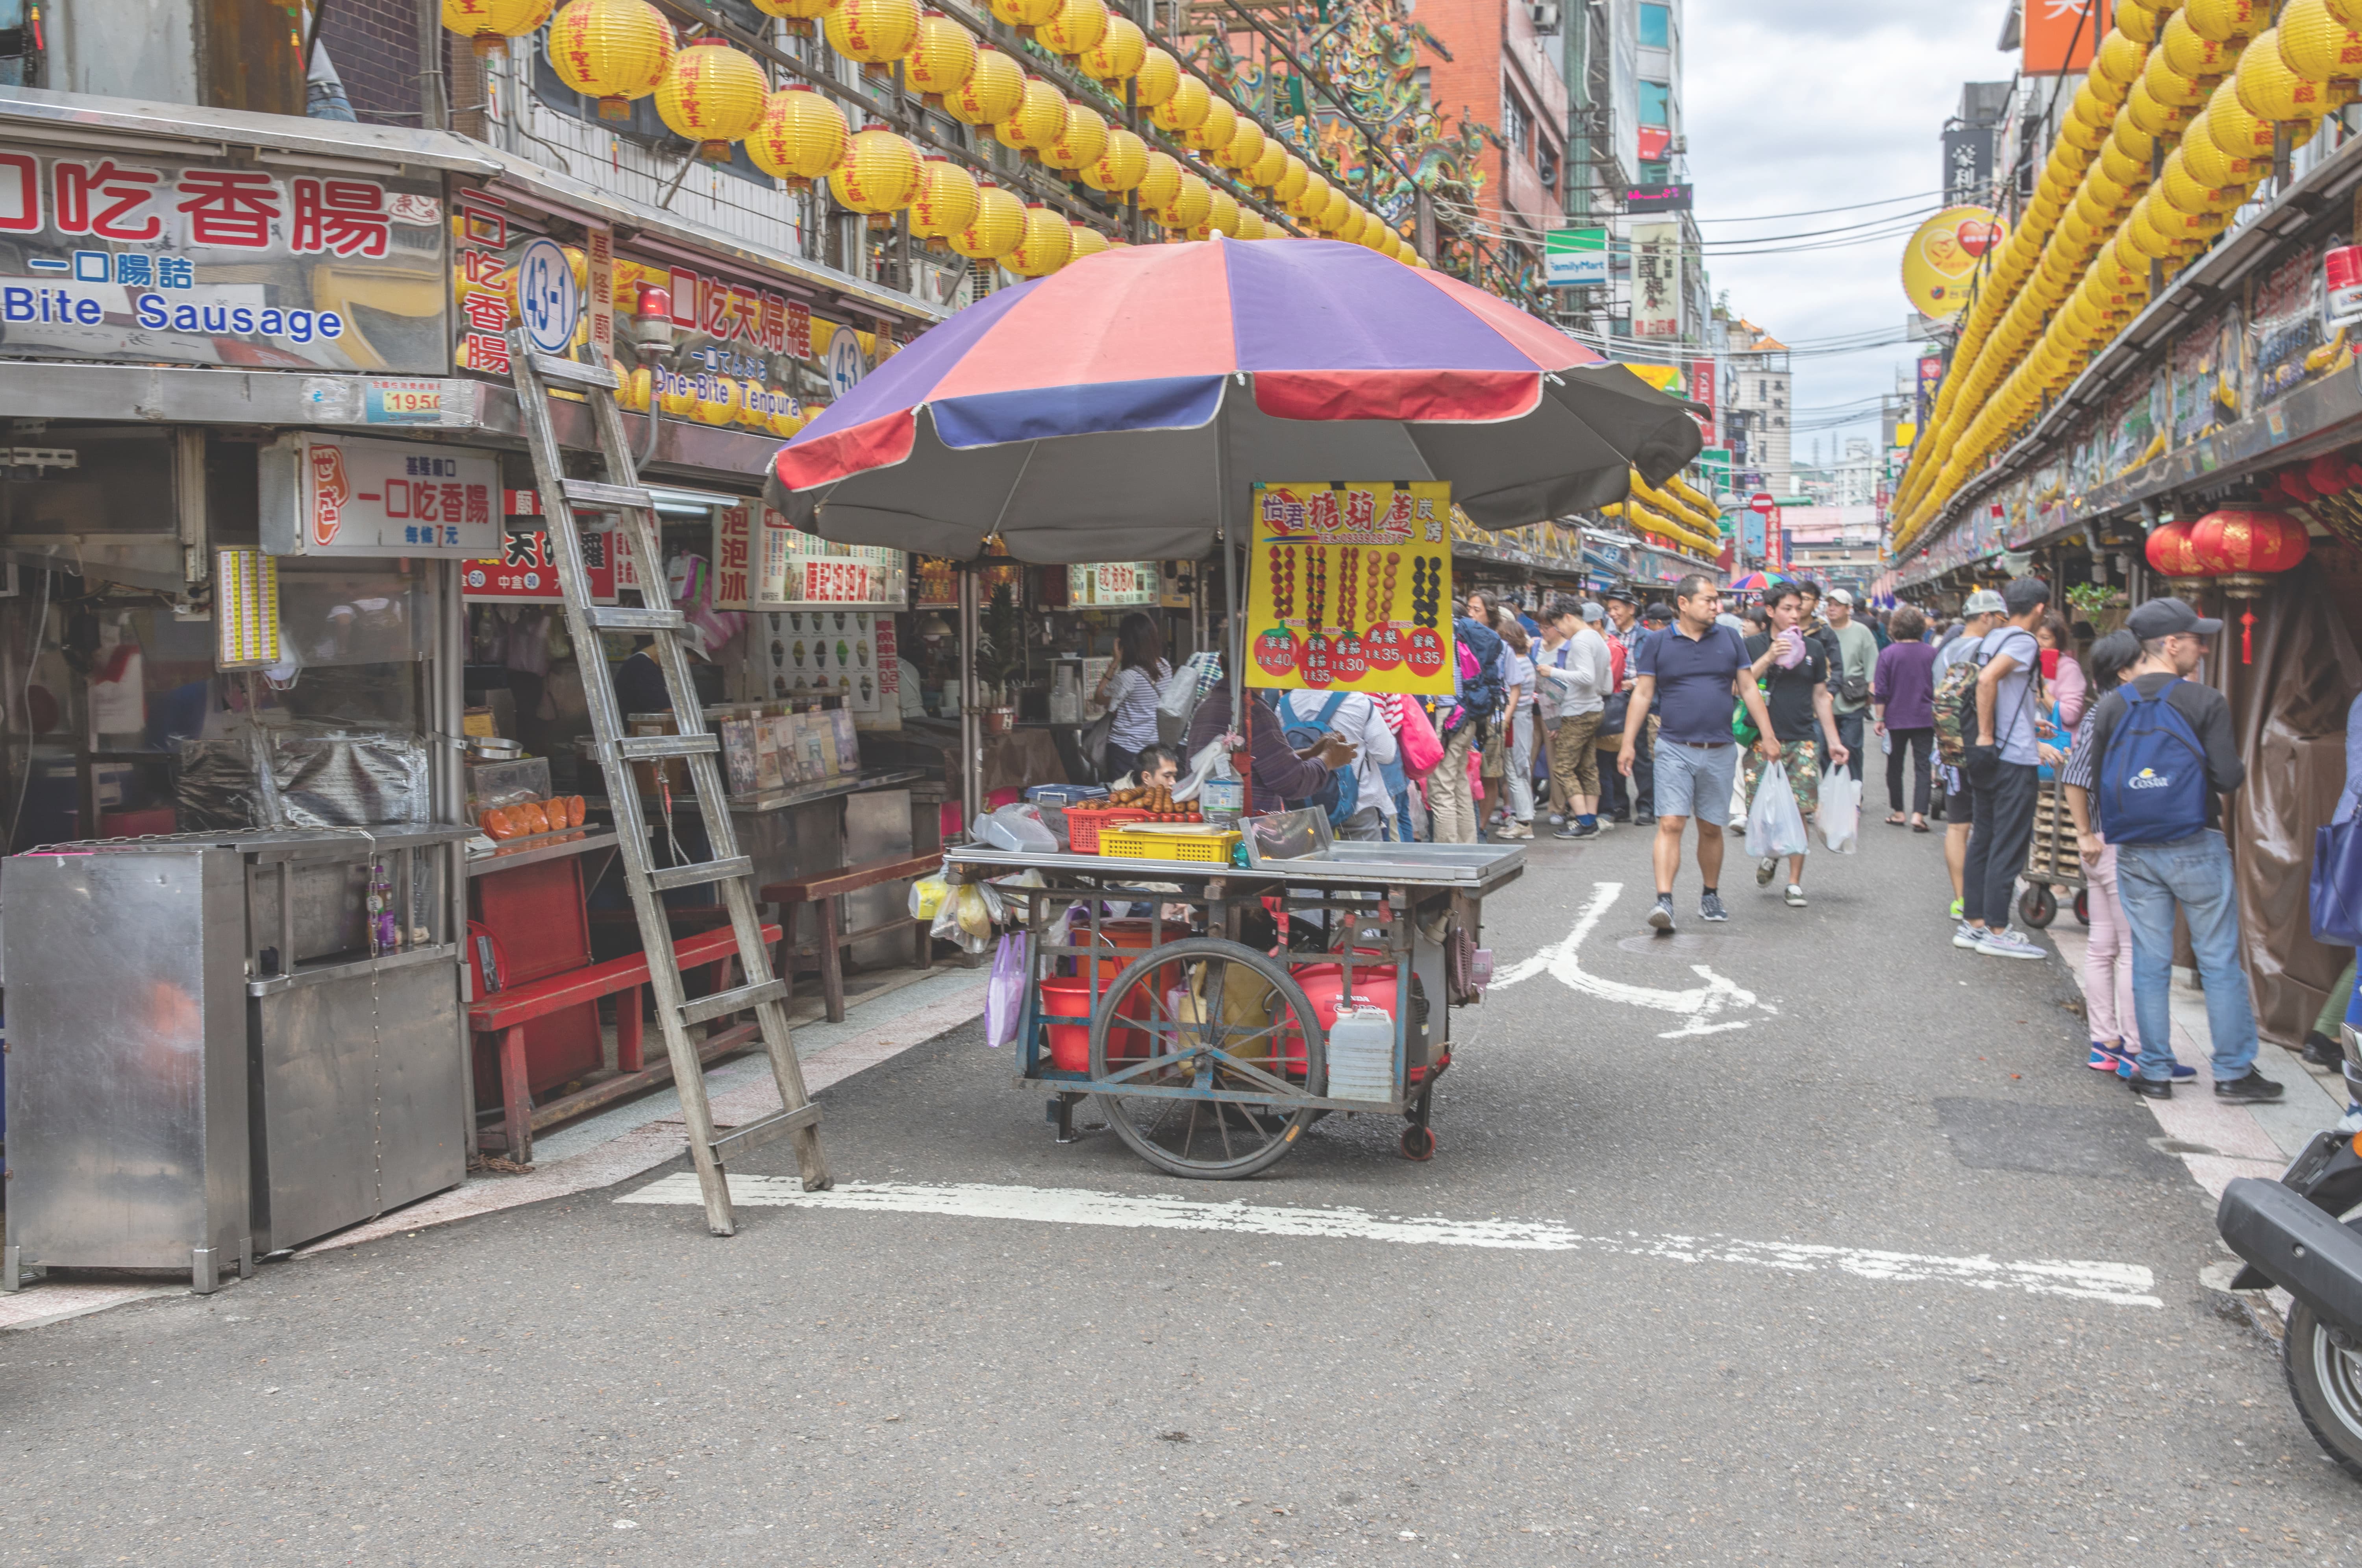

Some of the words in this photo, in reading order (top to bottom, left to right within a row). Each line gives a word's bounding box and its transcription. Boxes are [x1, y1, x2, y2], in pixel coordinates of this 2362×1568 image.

[30, 252, 194, 290] 一口腸詰
[462, 189, 510, 373] 一口吃香腸
[527, 257, 565, 334] 43-1
[592, 233, 610, 360] 基隆廟
[5, 287, 103, 325] Bite
[140, 294, 342, 342] Sausage
[635, 267, 811, 360] 一口吃天婦羅
[657, 364, 728, 405] One-Bite
[739, 381, 798, 419] Tenpura
[406, 457, 455, 477] 基隆廟口
[358, 479, 489, 524] 一口吃香腸
[1262, 494, 1306, 530] 怡君
[1307, 490, 1416, 538] 糖葫蘆
[719, 507, 748, 602] 泡泡冰
